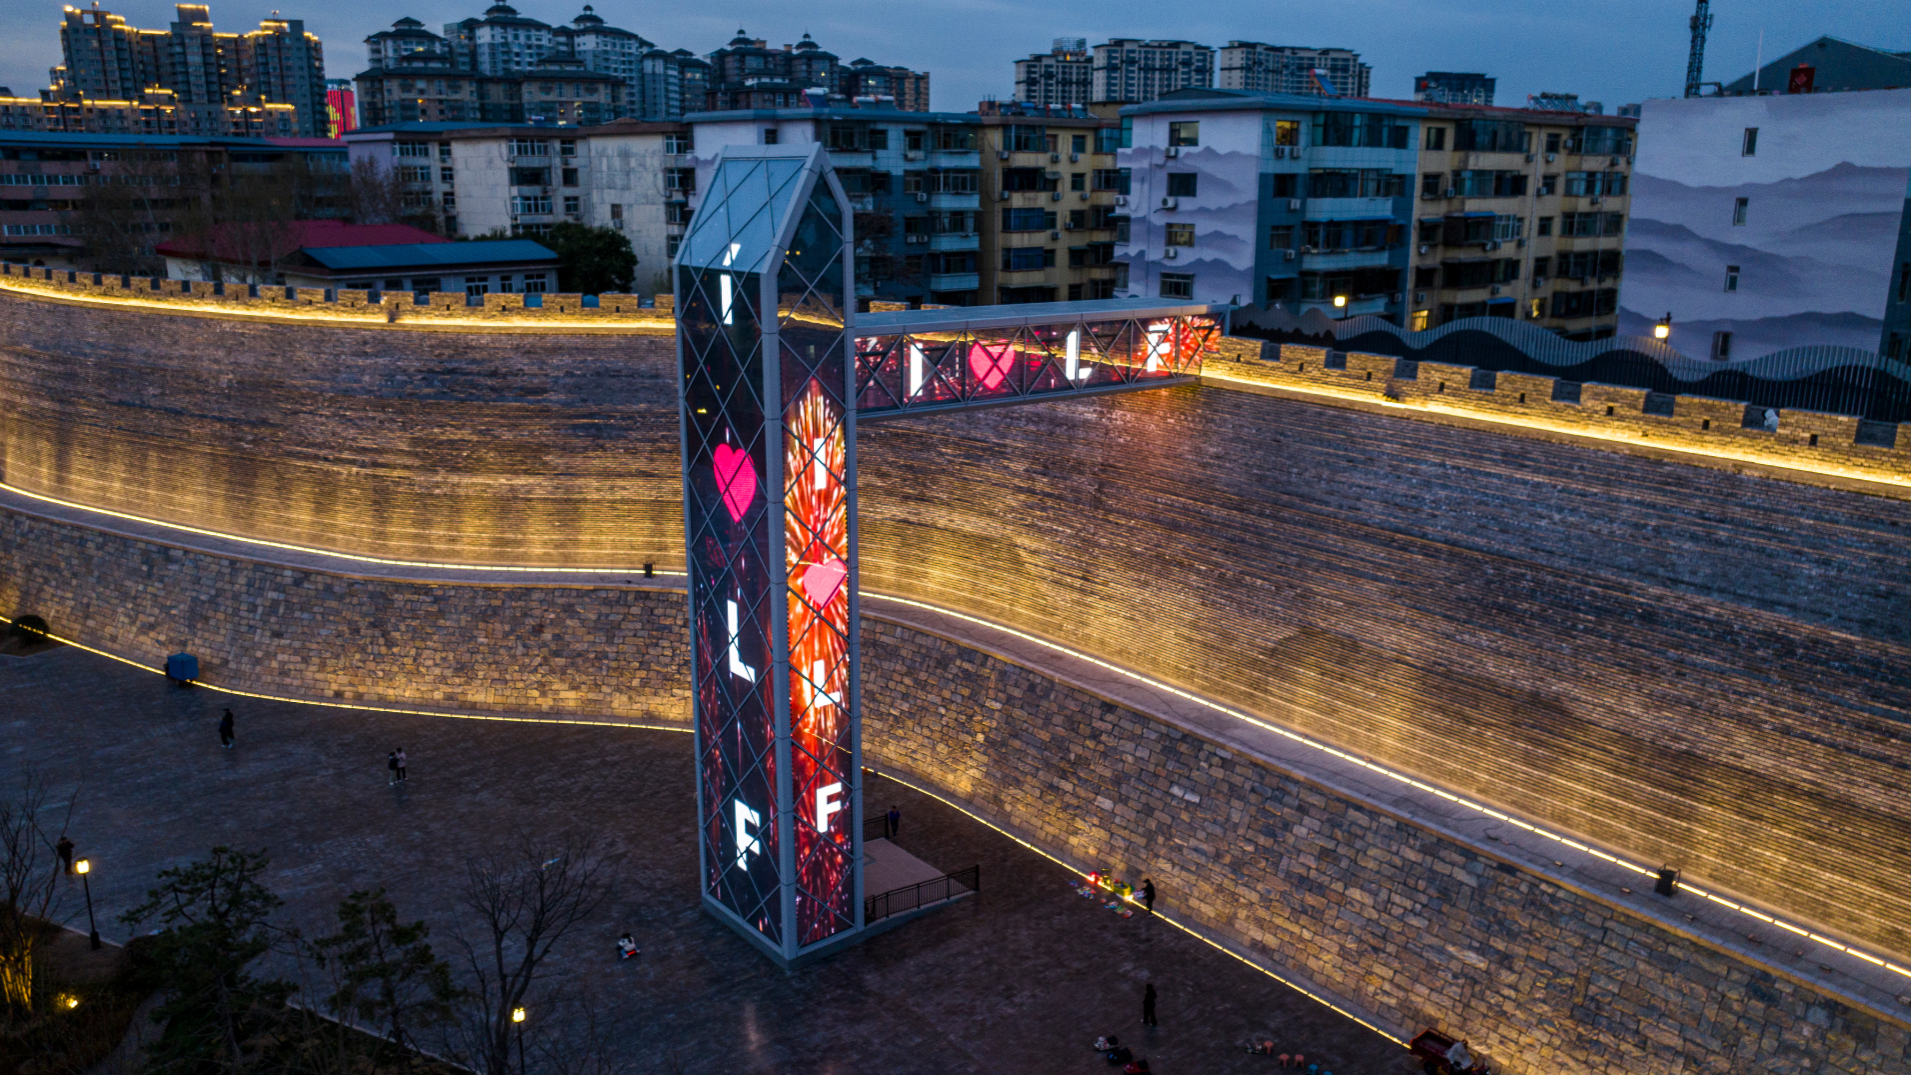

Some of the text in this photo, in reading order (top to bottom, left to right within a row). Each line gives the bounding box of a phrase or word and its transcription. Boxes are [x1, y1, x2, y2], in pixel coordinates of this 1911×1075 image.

[1065, 331, 1092, 380] L
[1147, 324, 1171, 372] F
[727, 599, 756, 684] L
[813, 659, 841, 708] L
[734, 798, 760, 872] F
[816, 782, 842, 833] F
